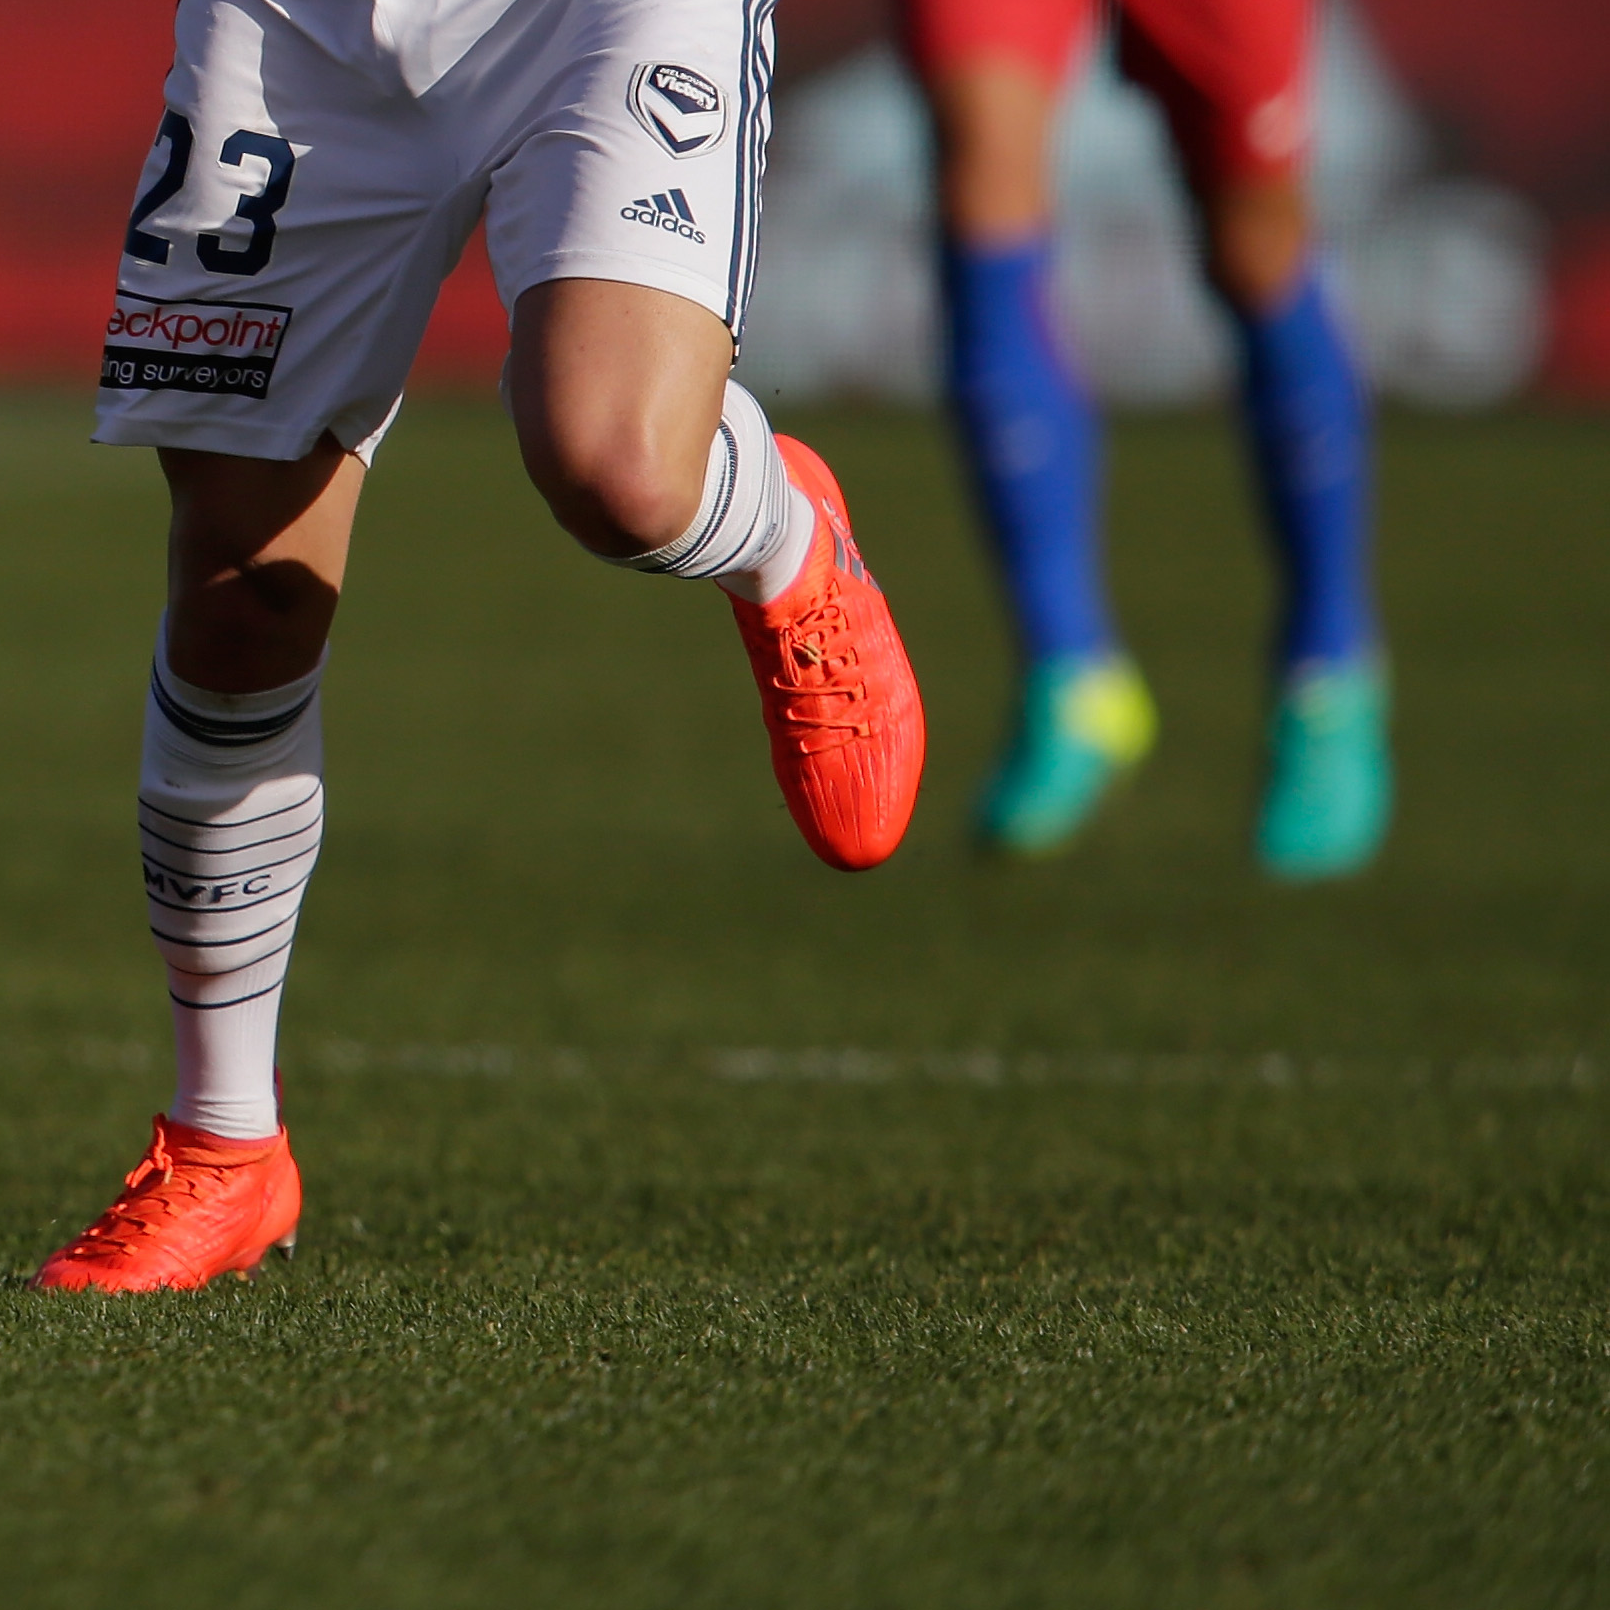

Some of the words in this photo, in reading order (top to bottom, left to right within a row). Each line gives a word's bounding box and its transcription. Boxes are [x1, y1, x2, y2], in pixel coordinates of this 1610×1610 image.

[655, 73, 717, 110] Victory
[124, 108, 296, 277] 23
[620, 205, 707, 245] adidas
[106, 306, 281, 350] eckpoint
[102, 354, 137, 384] ing
[142, 360, 267, 389] surveyors
[142, 861, 272, 904] MVFC
